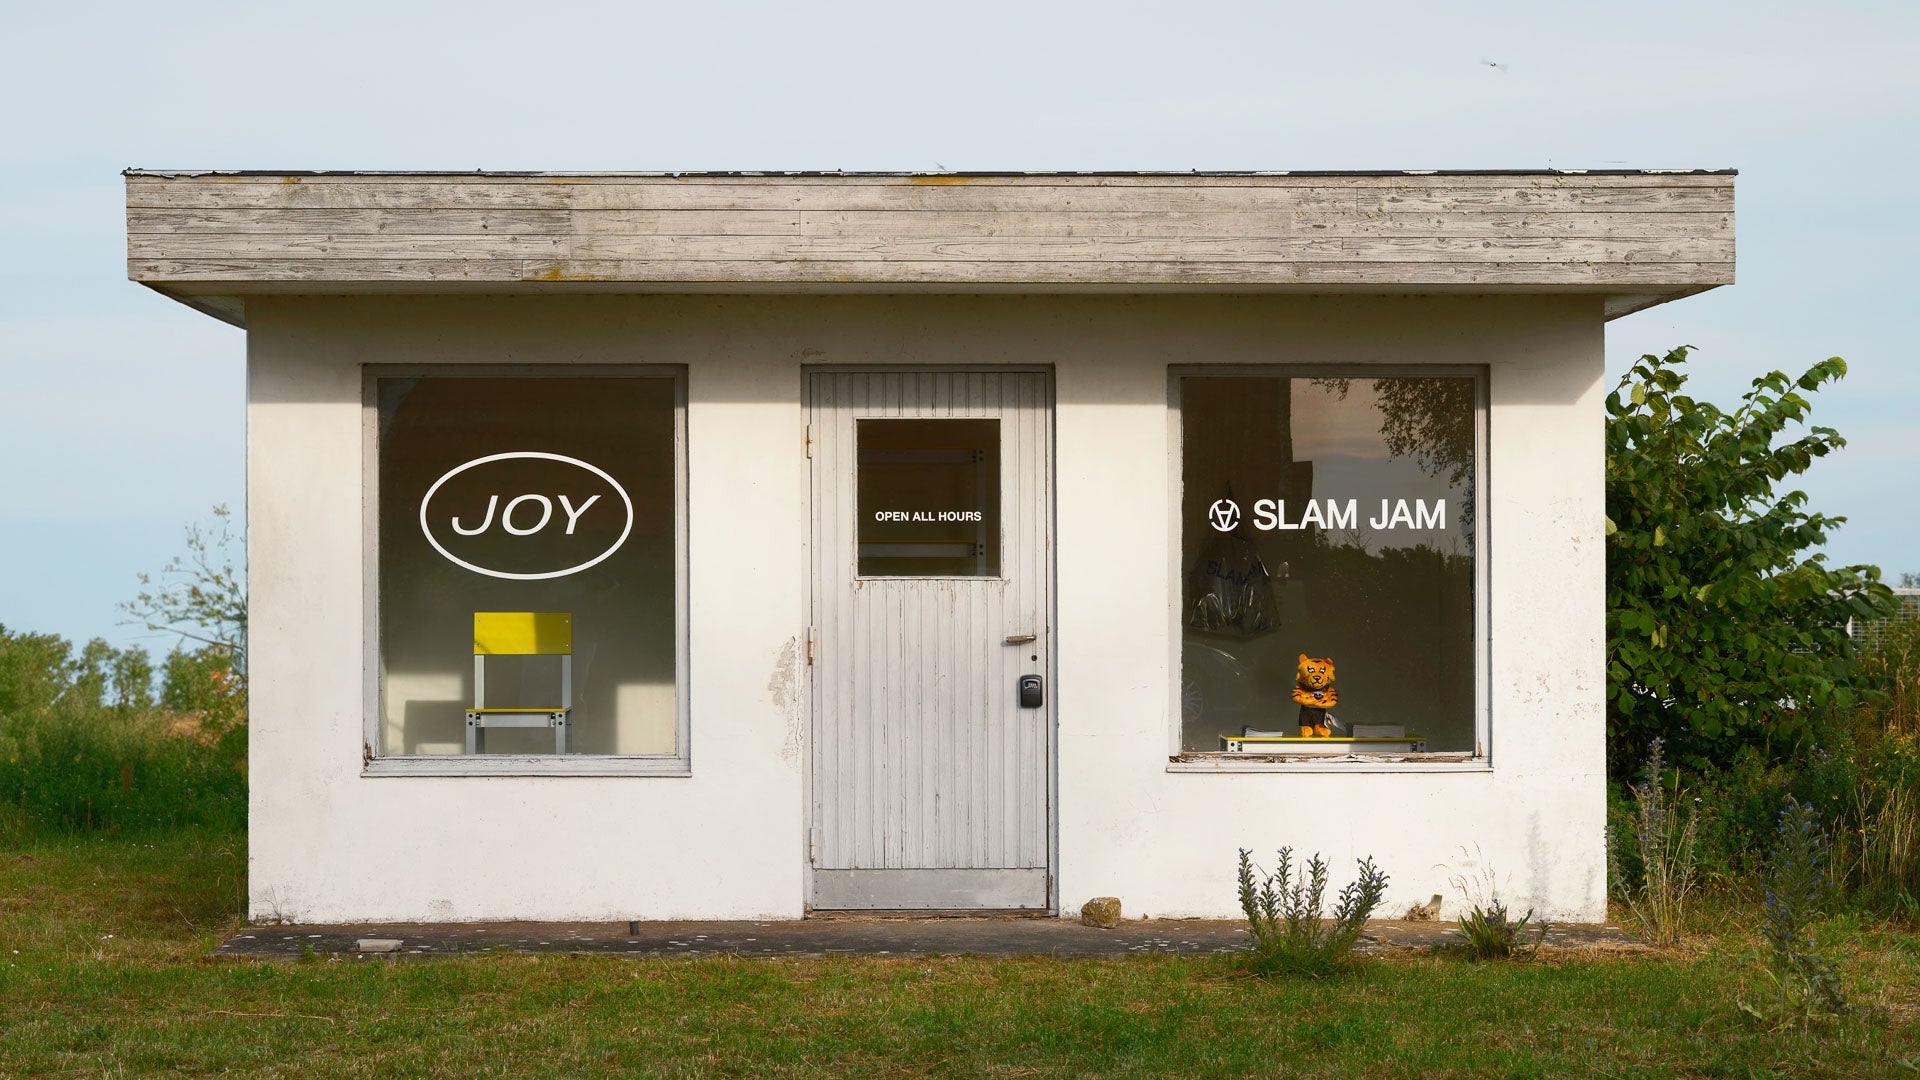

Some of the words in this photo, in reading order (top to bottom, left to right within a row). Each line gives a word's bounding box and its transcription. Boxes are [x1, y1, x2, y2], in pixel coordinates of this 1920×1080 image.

[451, 494, 601, 536] JOY
[875, 511, 910, 522] OPEN
[912, 511, 936, 522] ALL
[938, 511, 982, 522] HOURS
[1253, 498, 1358, 531] SLAM
[1369, 498, 1446, 531] JAM
